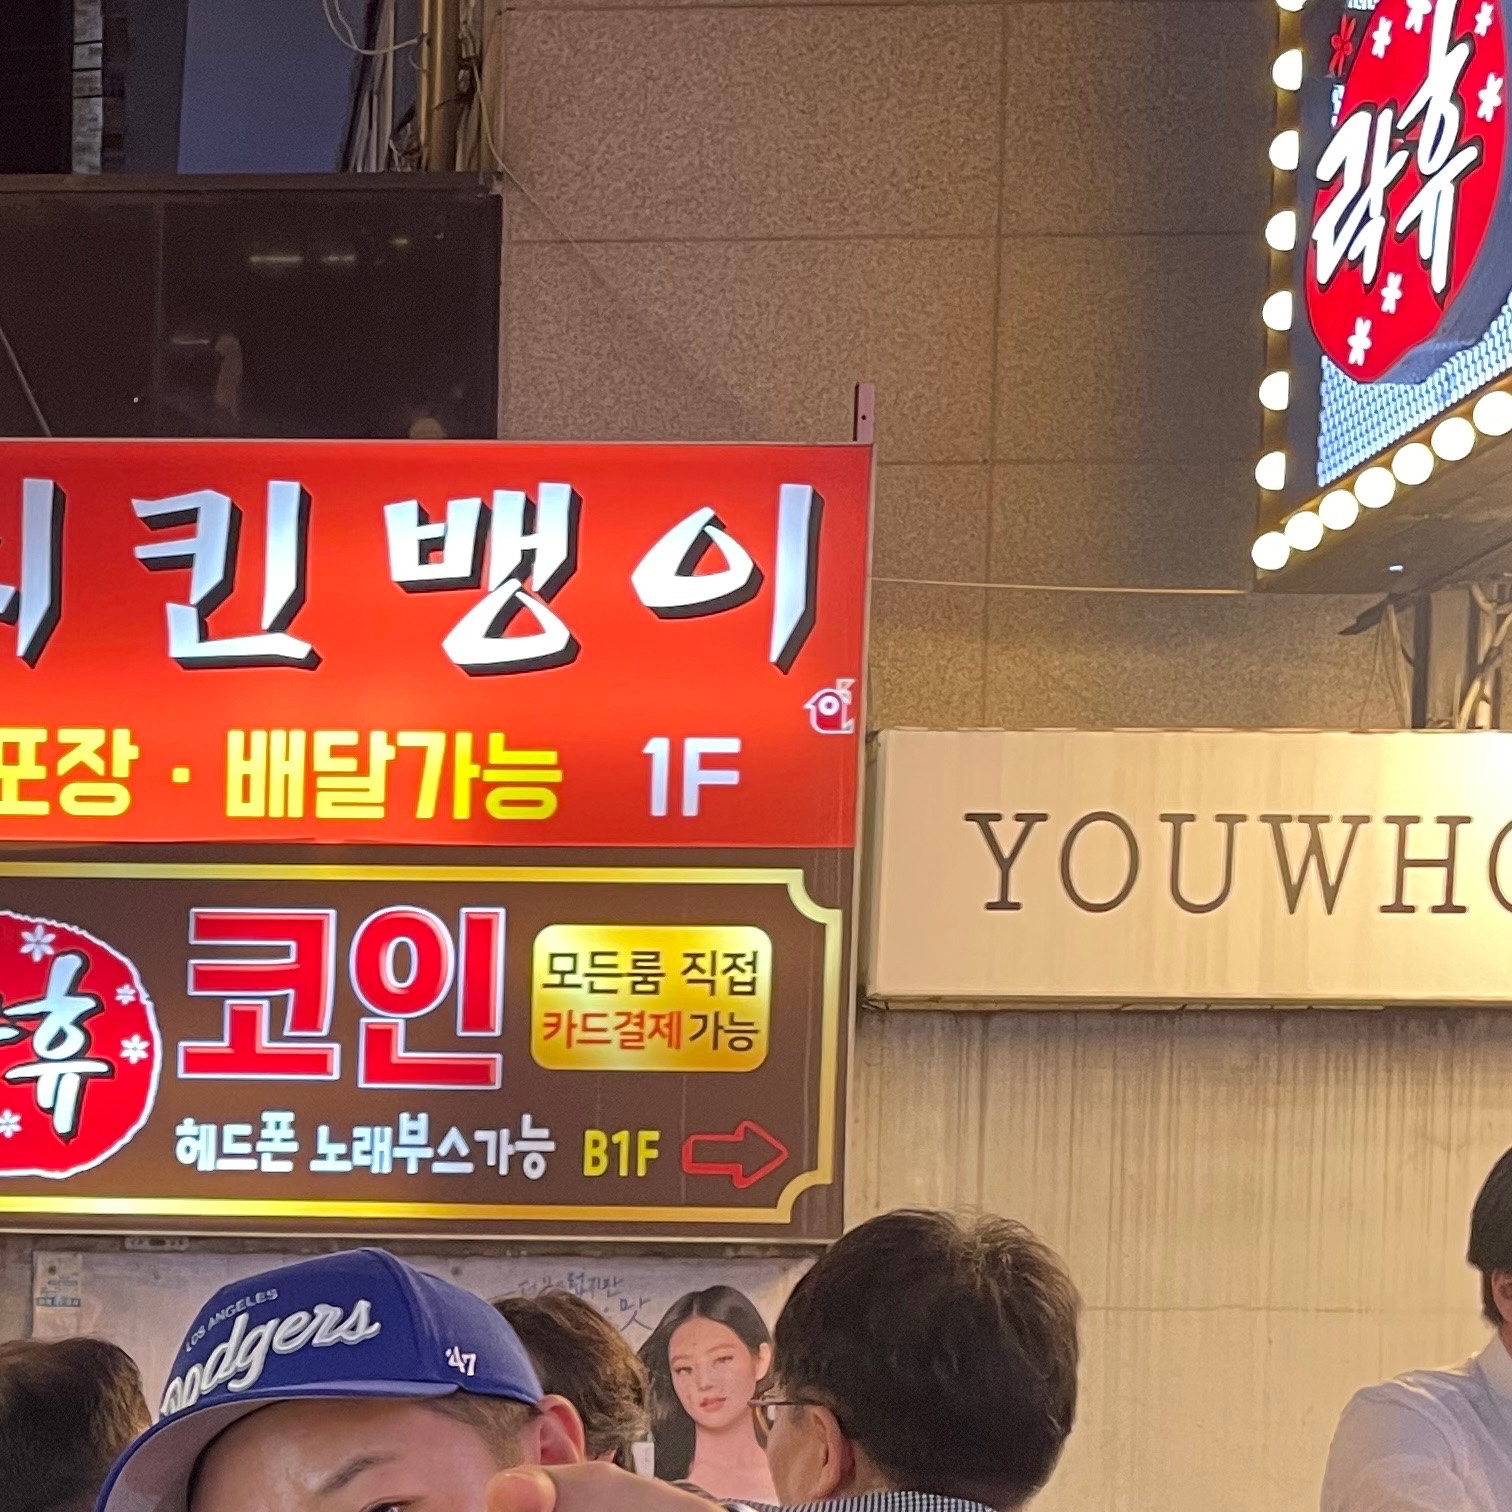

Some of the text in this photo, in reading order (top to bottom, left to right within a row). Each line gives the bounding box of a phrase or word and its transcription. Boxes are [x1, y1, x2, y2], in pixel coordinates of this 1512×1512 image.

[226, 729, 563, 820] 배달가능
[642, 736, 742, 817] 1F
[176, 905, 507, 1091] 코인
[542, 949, 759, 997] 모든룸 직접
[174, 1110, 661, 1180] 헤드폰 노래부스가능 B1F
[208, 1289, 279, 1330] ANGELES
